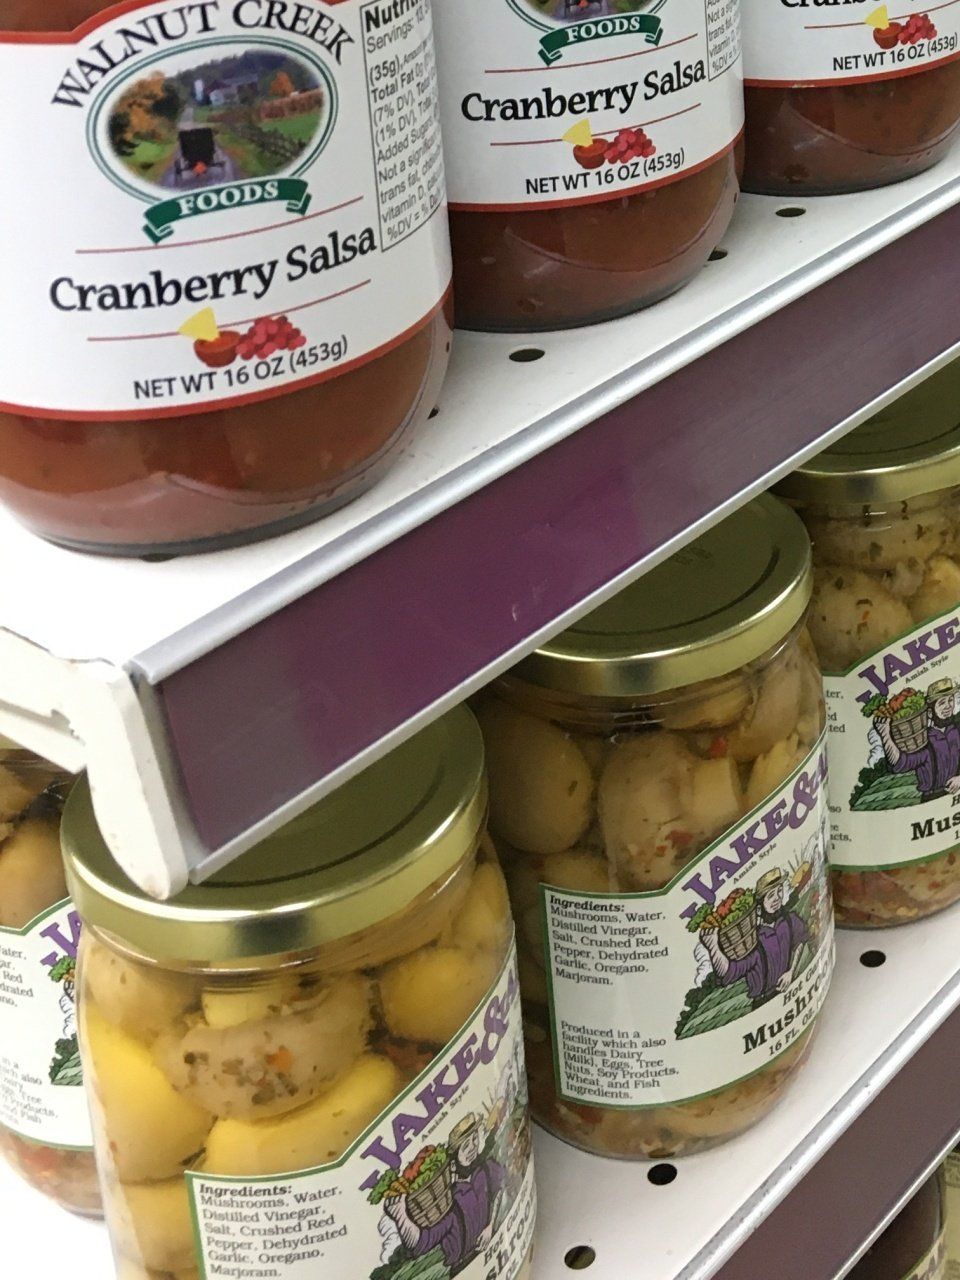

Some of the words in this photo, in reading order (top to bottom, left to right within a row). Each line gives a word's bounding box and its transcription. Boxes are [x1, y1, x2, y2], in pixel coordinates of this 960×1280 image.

[566, 16, 641, 43] FOODS
[51, 0, 220, 110] WALNUT
[832, 54, 862, 72] NET
[863, 51, 887, 70] WT
[889, 48, 906, 64] 16
[906, 43, 926, 61] OZ
[926, 32, 958, 58] (453g)
[460, 79, 639, 122] Cranberry
[642, 59, 707, 103] Salsa
[525, 176, 560, 196] NET
[561, 173, 592, 192] WT
[593, 168, 615, 187] 16
[616, 161, 642, 183] OZ
[641, 147, 686, 179] (453g)
[178, 180, 281, 218] FOODS
[49, 258, 280, 313] Cranberry
[285, 226, 378, 283] Salsa
[133, 376, 178, 400] NET
[180, 370, 218, 395] WT
[223, 362, 250, 387] 16
[253, 355, 285, 380] OZ
[288, 334, 349, 374] (453g)
[904, 665, 930, 685] Amish
[929, 654, 950, 670] Style
[550, 894, 626, 913] Ingredients:
[550, 906, 623, 924] Mushrooms,
[625, 911, 667, 923] Water,
[551, 918, 598, 936] Distilled
[599, 924, 652, 939] Vinegar,
[551, 930, 578, 947] Salt,
[579, 934, 637, 948] Crushed
[639, 935, 660, 948] Red
[598, 946, 670, 962] Dehydrated
[554, 966, 615, 987] Marjoram.
[560, 1020, 616, 1040] Produced
[565, 1082, 634, 1101] Ingredients.
[199, 1182, 293, 1200] Ingredients:
